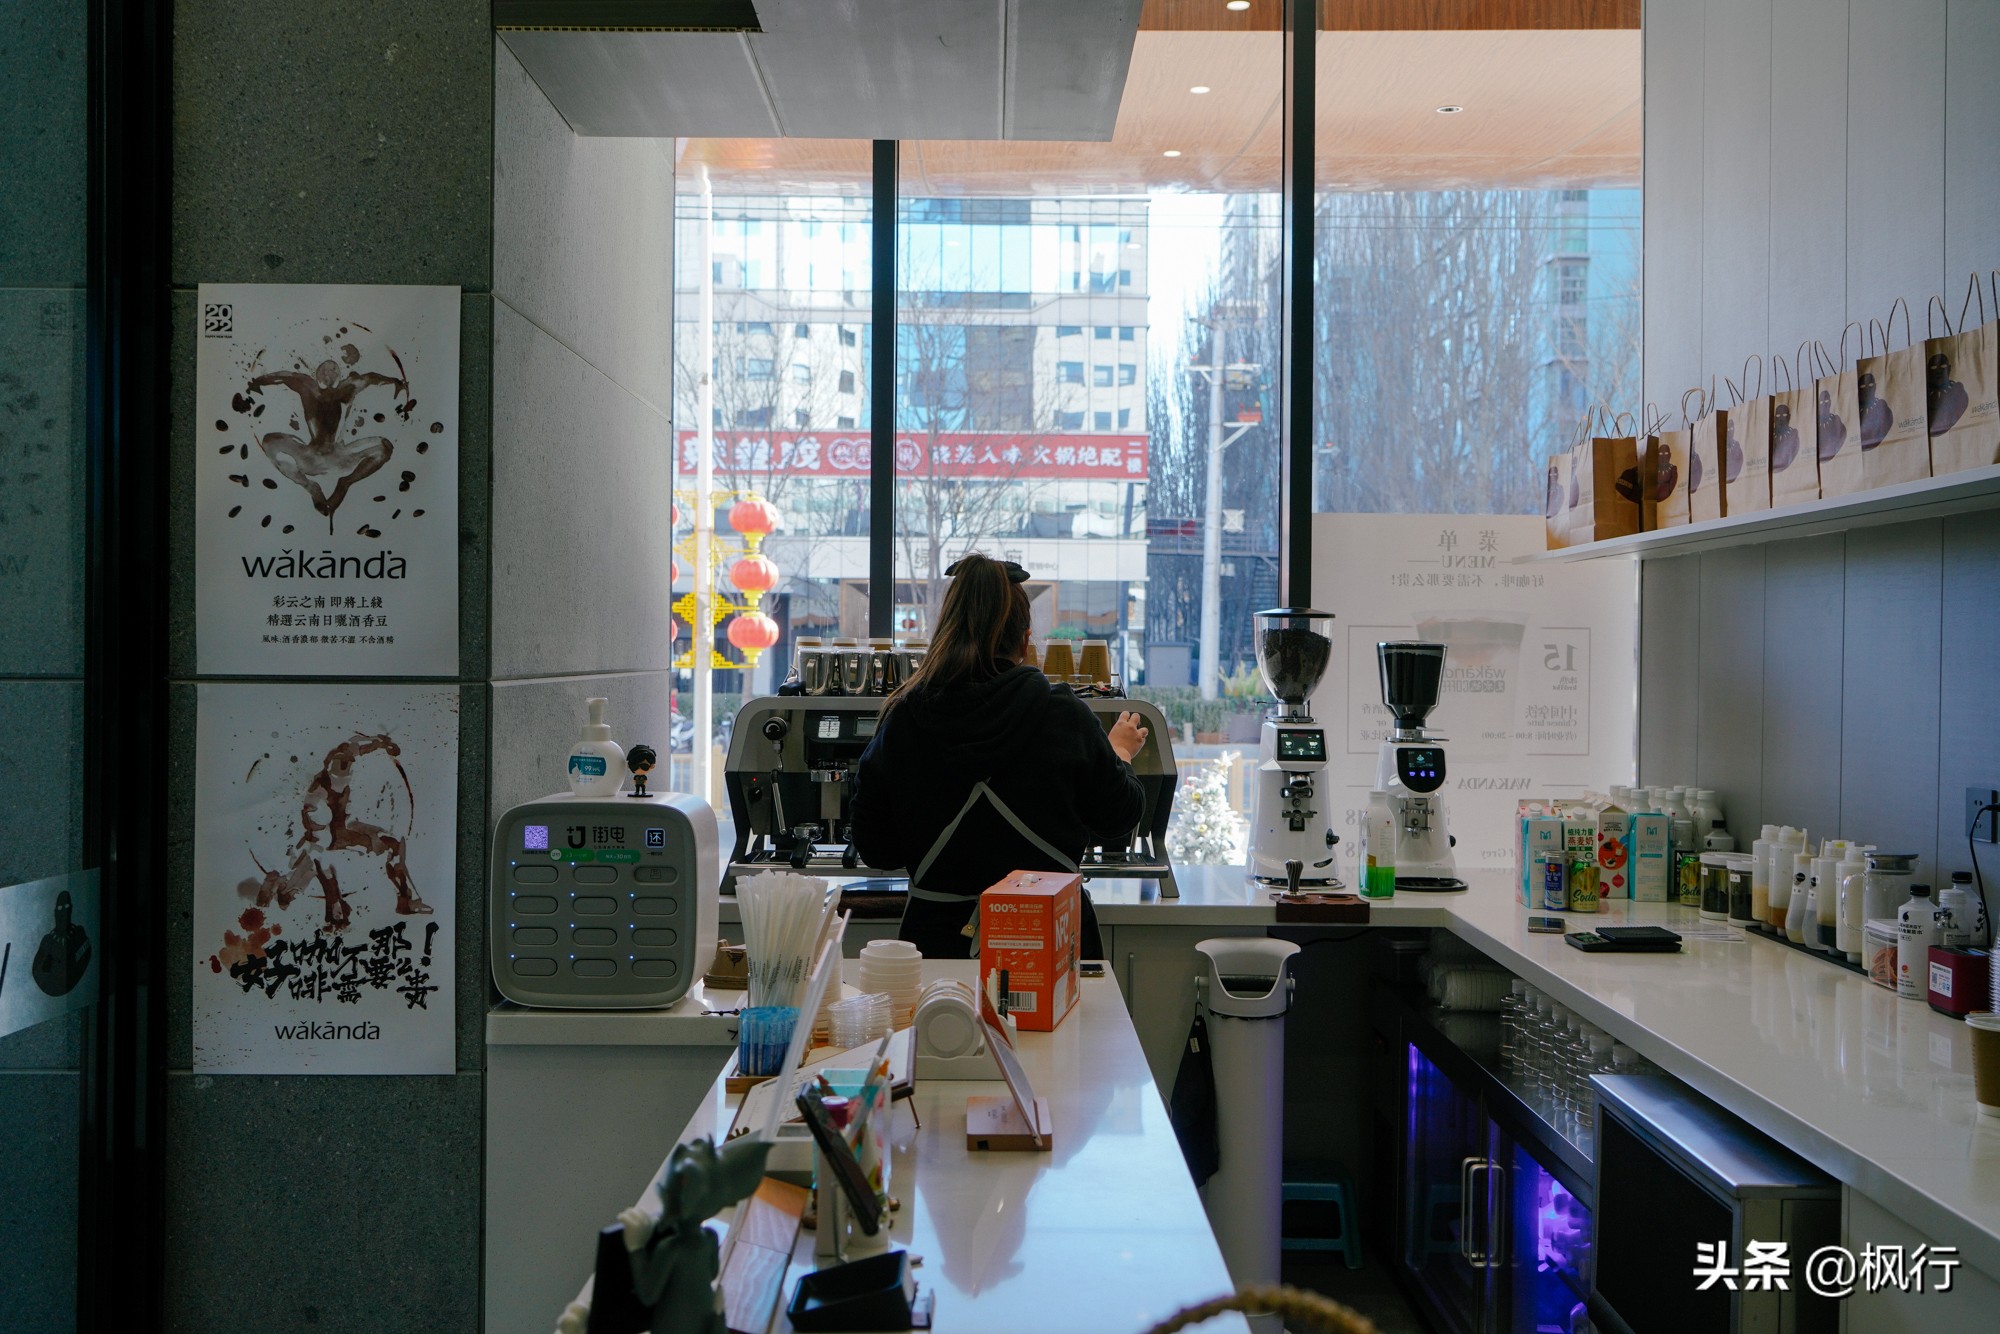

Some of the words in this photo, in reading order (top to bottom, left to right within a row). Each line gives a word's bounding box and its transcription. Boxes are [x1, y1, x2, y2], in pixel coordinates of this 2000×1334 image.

[272, 595, 326, 609] 彩云之南
[592, 826, 625, 844] 街电
[648, 832, 662, 845] 还
[1567, 836, 1594, 846] 燕麦奶
[1572, 889, 1597, 903] Soda
[988, 903, 1018, 914] 100%
[1055, 912, 1070, 951] NFC
